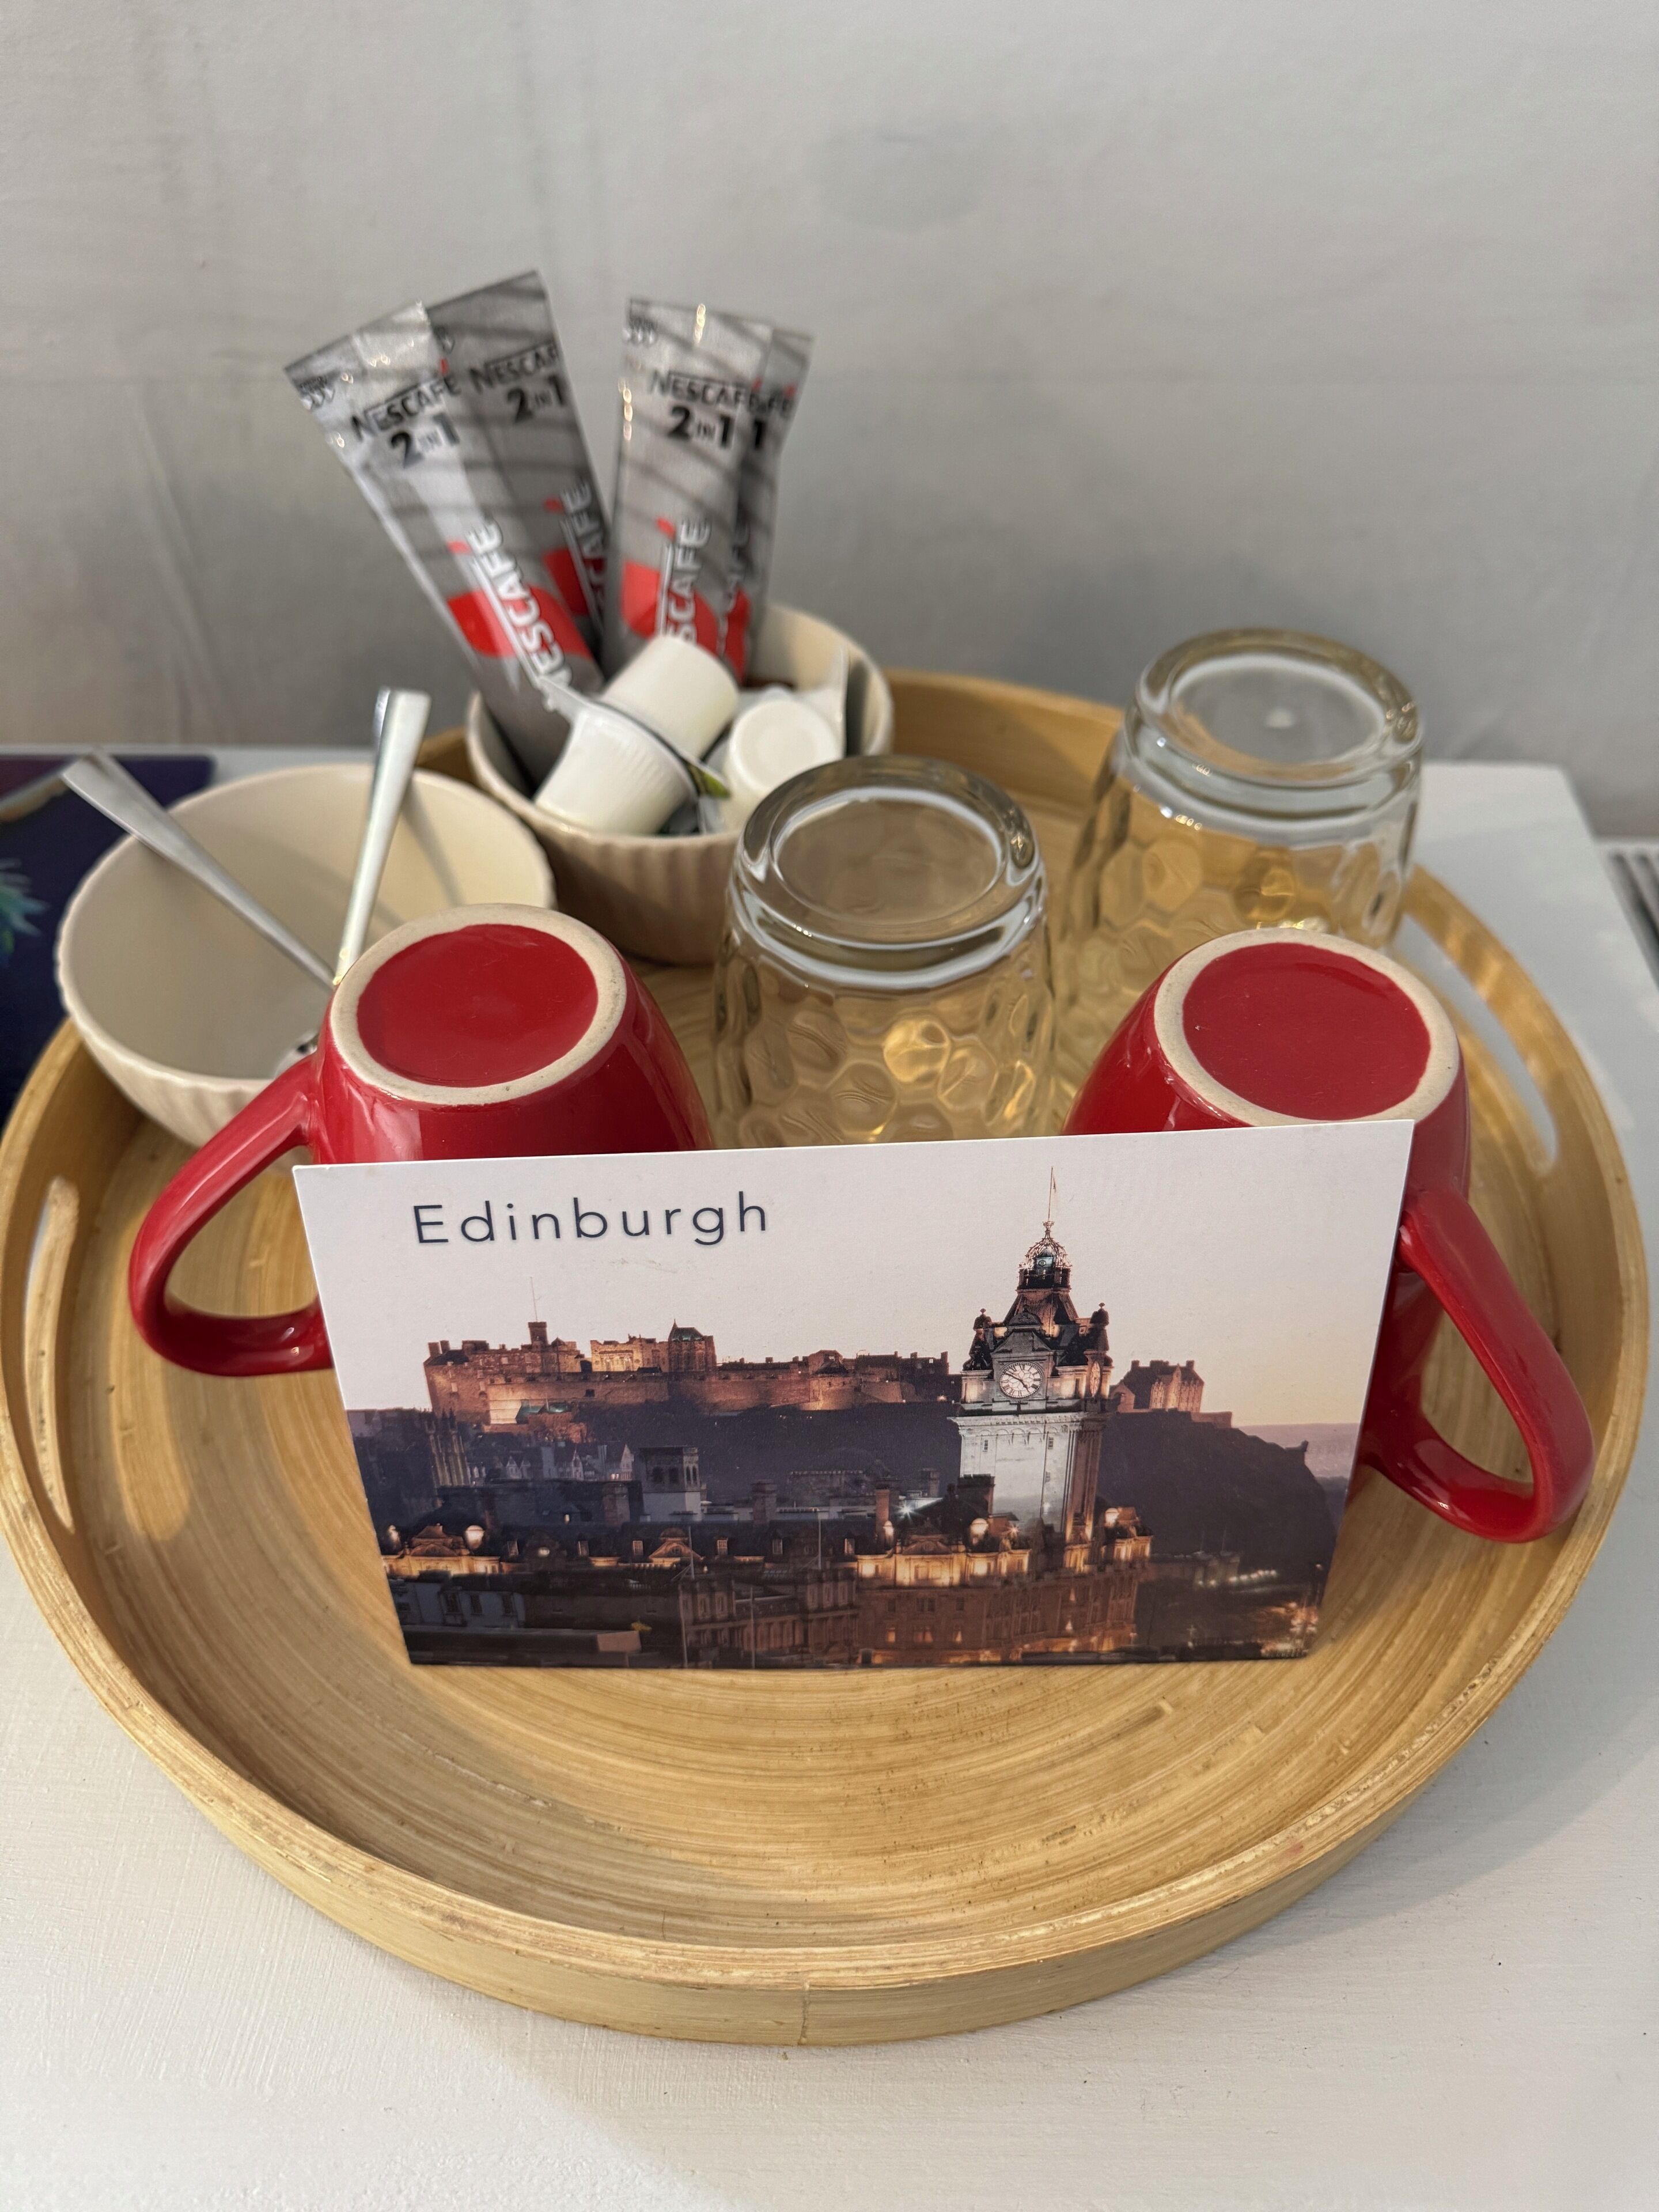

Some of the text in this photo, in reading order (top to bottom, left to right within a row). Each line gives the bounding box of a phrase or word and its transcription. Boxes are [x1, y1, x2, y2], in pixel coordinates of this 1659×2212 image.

[506, 387, 534, 425] 2
[546, 373, 566, 407] 1
[390, 430, 425, 469] 2
[431, 412, 460, 445] 1
[668, 405, 691, 440] 2
[718, 413, 733, 448] 1
[413, 1190, 767, 1246] Edinburgh
